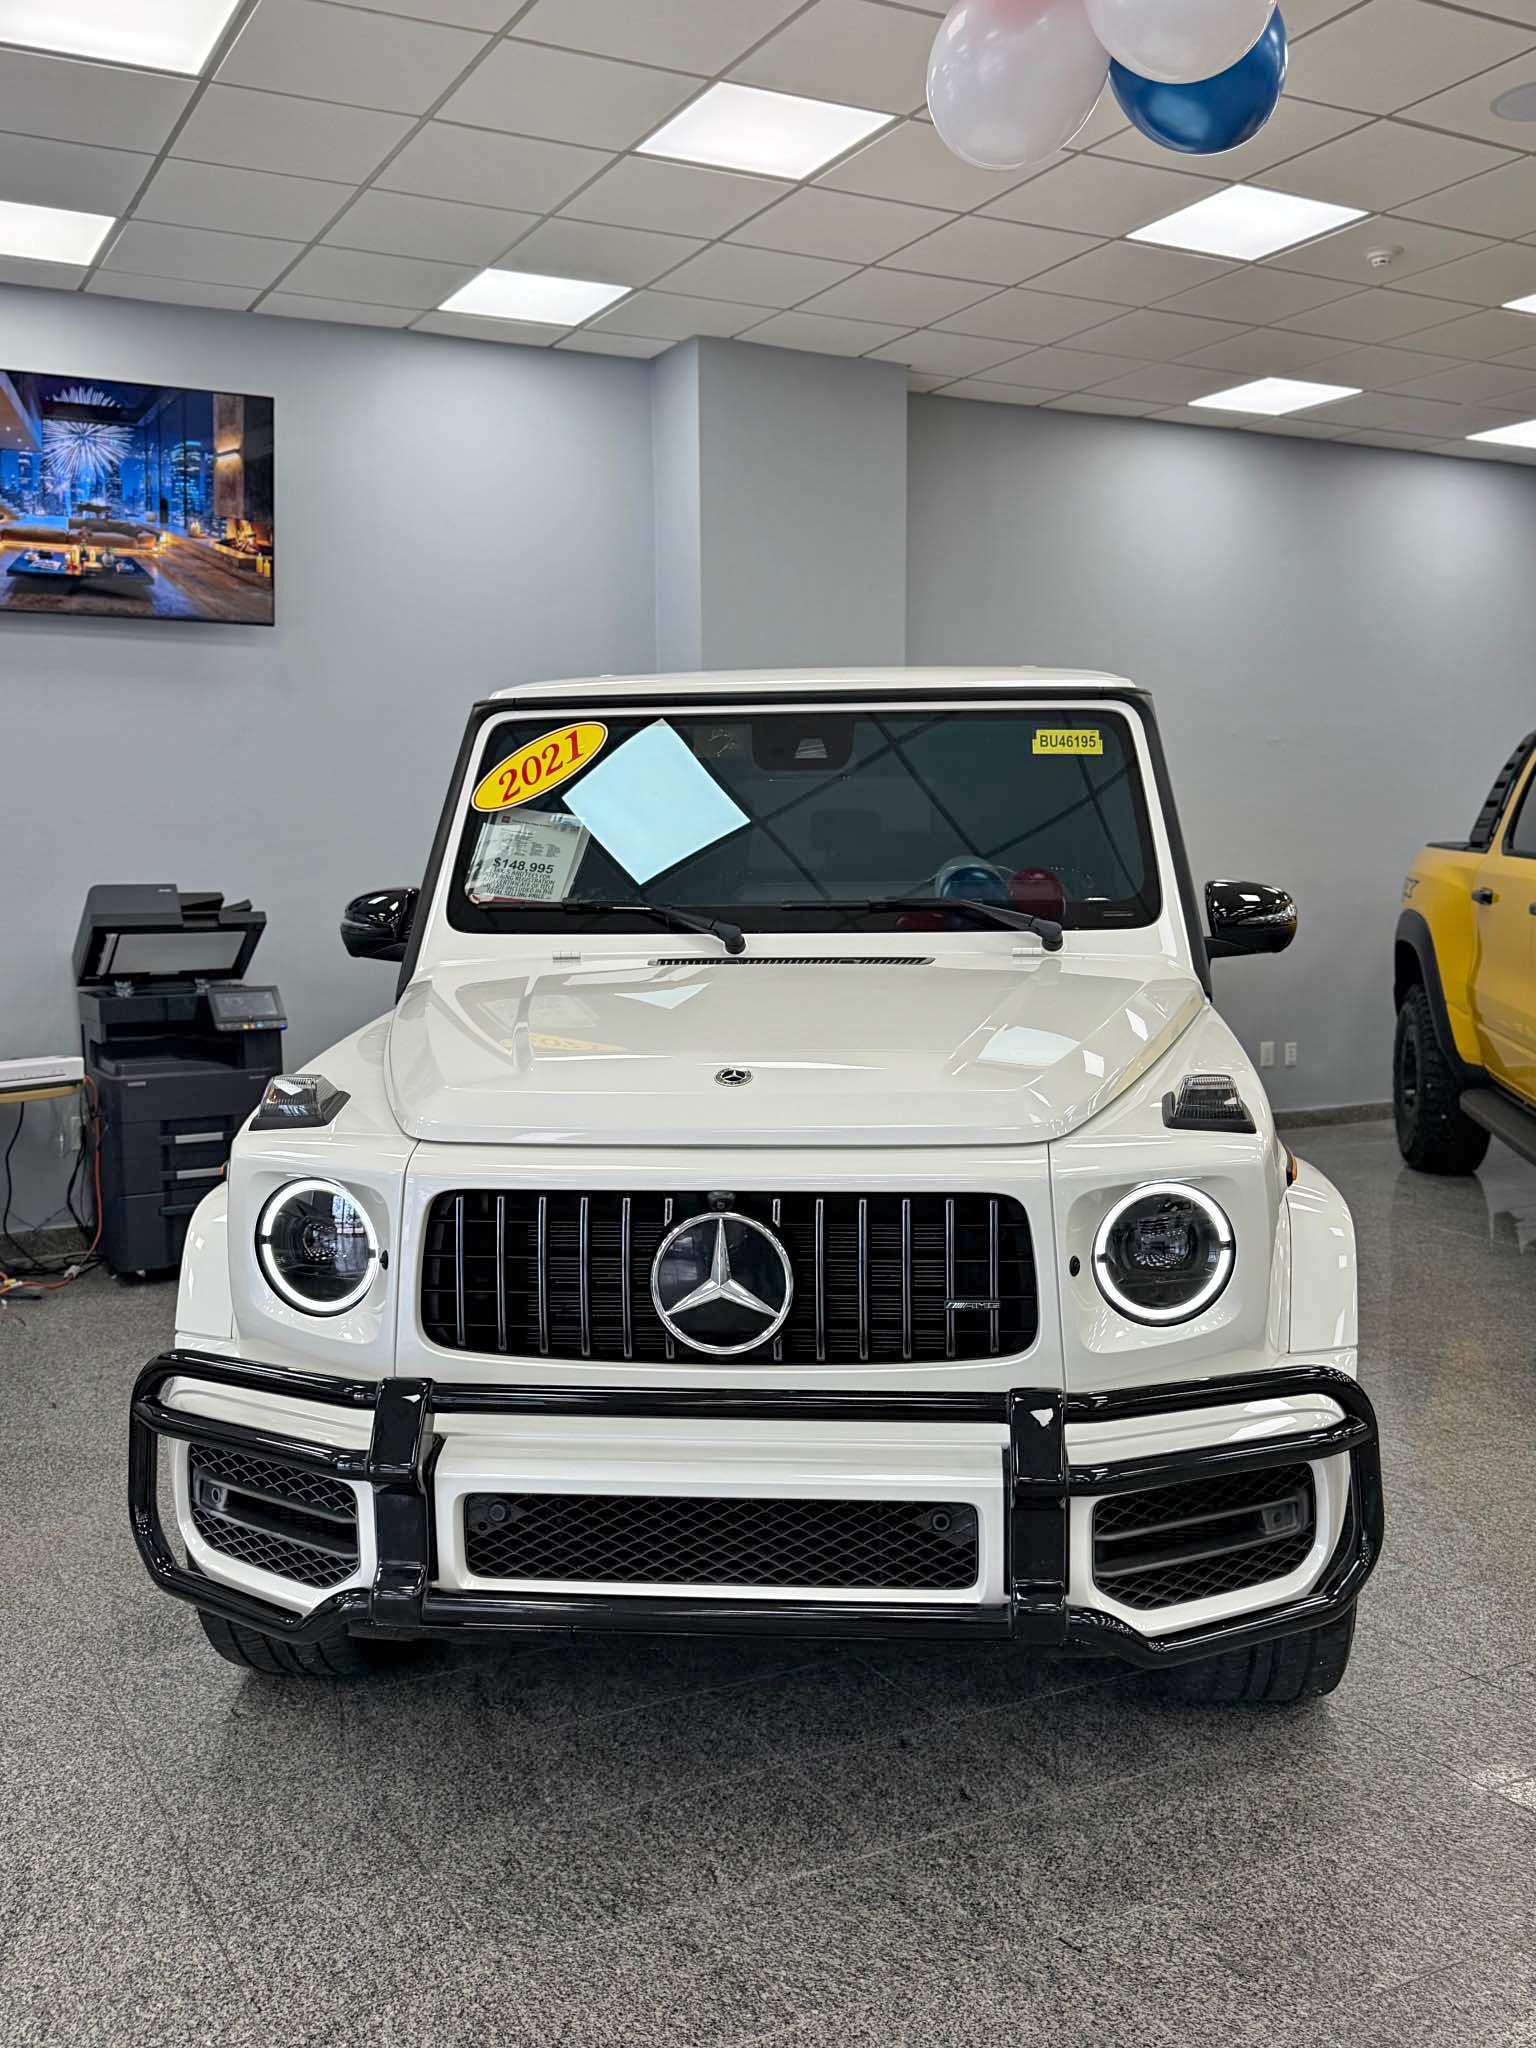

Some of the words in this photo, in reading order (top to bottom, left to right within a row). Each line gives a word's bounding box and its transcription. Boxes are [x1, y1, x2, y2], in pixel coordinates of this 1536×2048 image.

[1040, 735, 1096, 748] BU46195
[499, 730, 583, 802] 2021
[493, 857, 554, 874] $148,995
